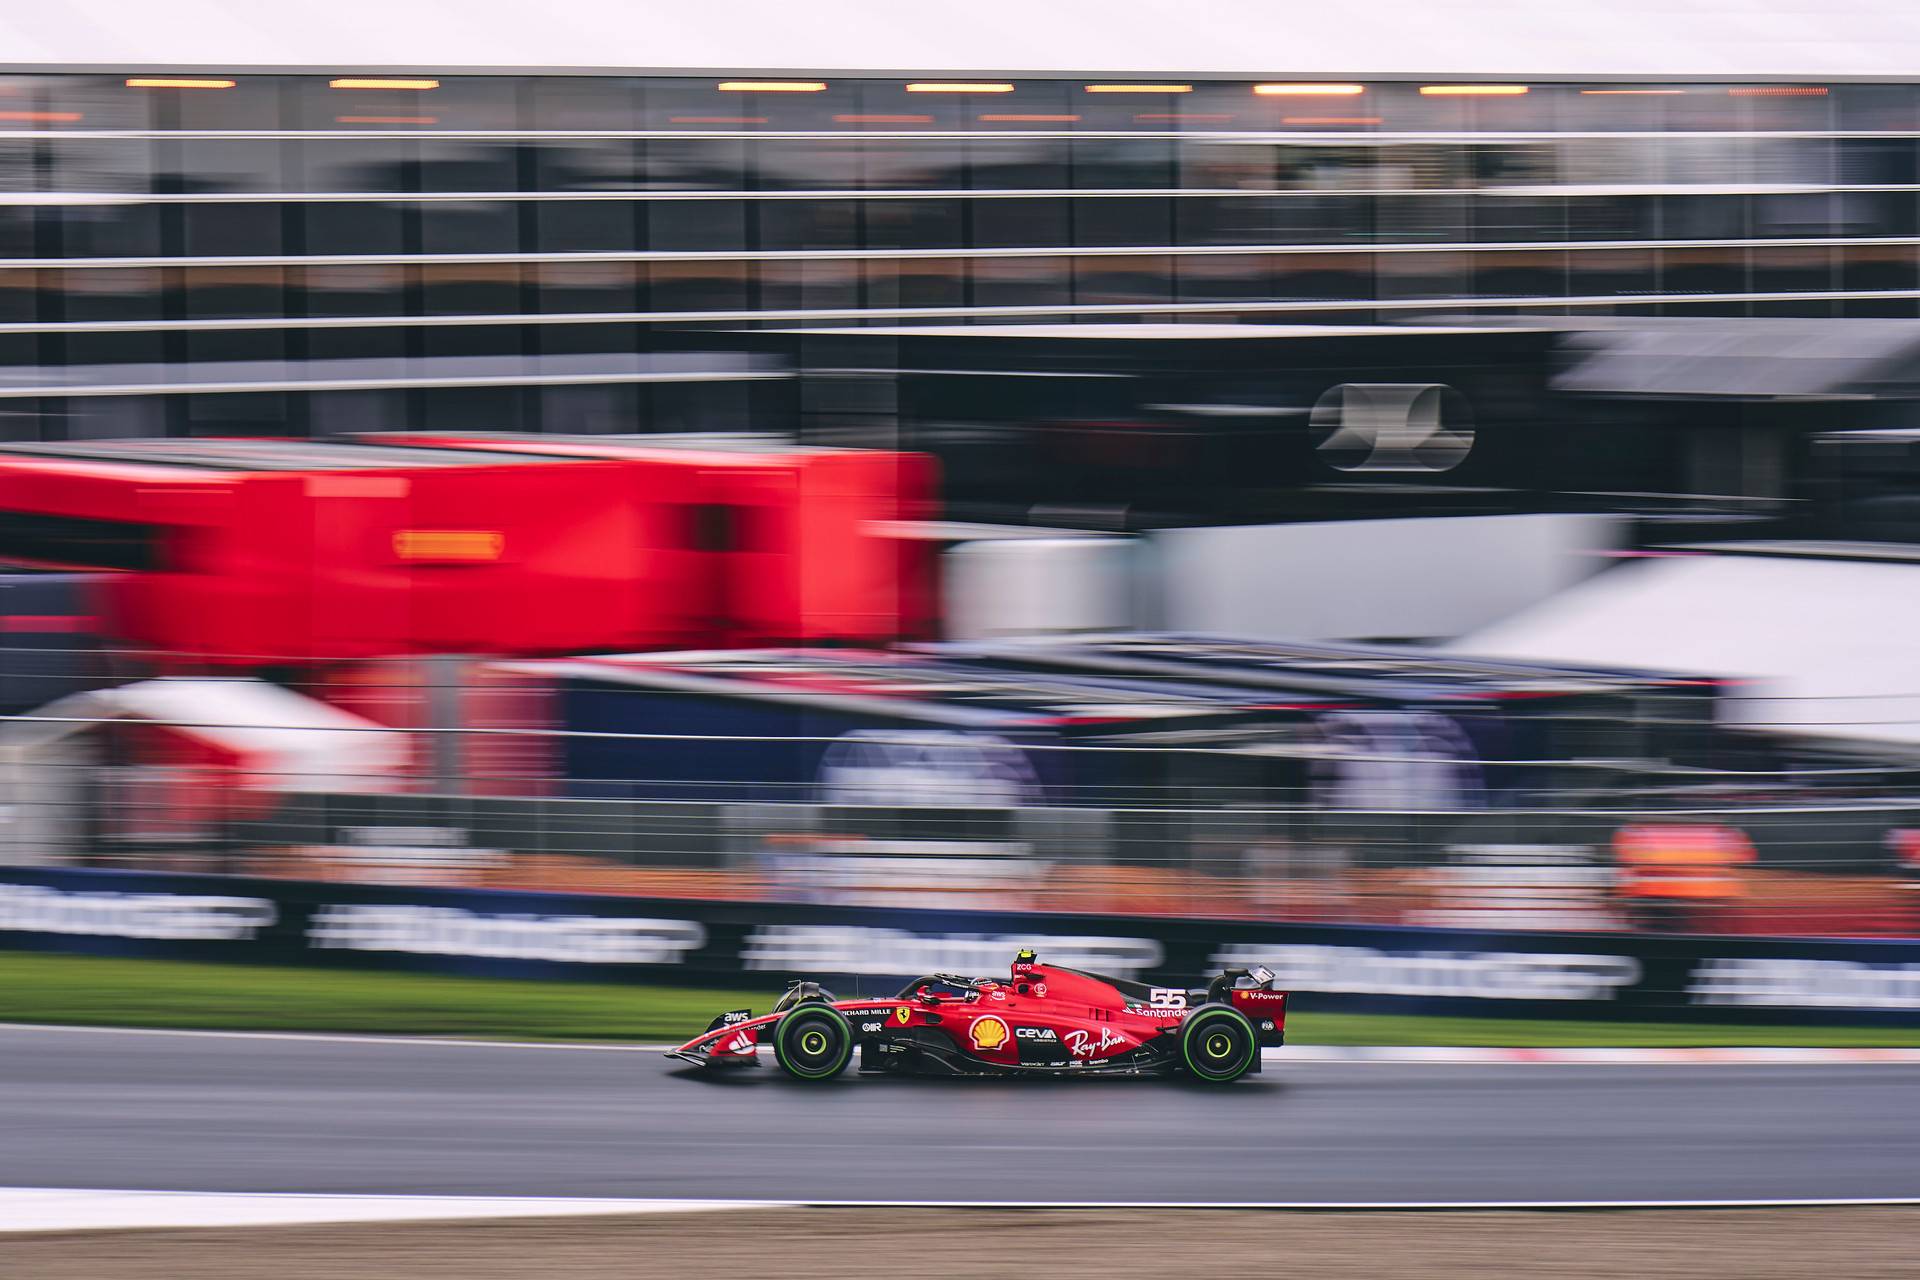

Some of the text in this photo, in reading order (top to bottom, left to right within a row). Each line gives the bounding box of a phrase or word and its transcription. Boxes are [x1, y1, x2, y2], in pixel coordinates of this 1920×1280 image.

[1016, 963, 1032, 971] ZCG
[1150, 988, 1187, 1009] 55
[1250, 992, 1284, 1000] V-Power
[724, 1012, 749, 1022] aws
